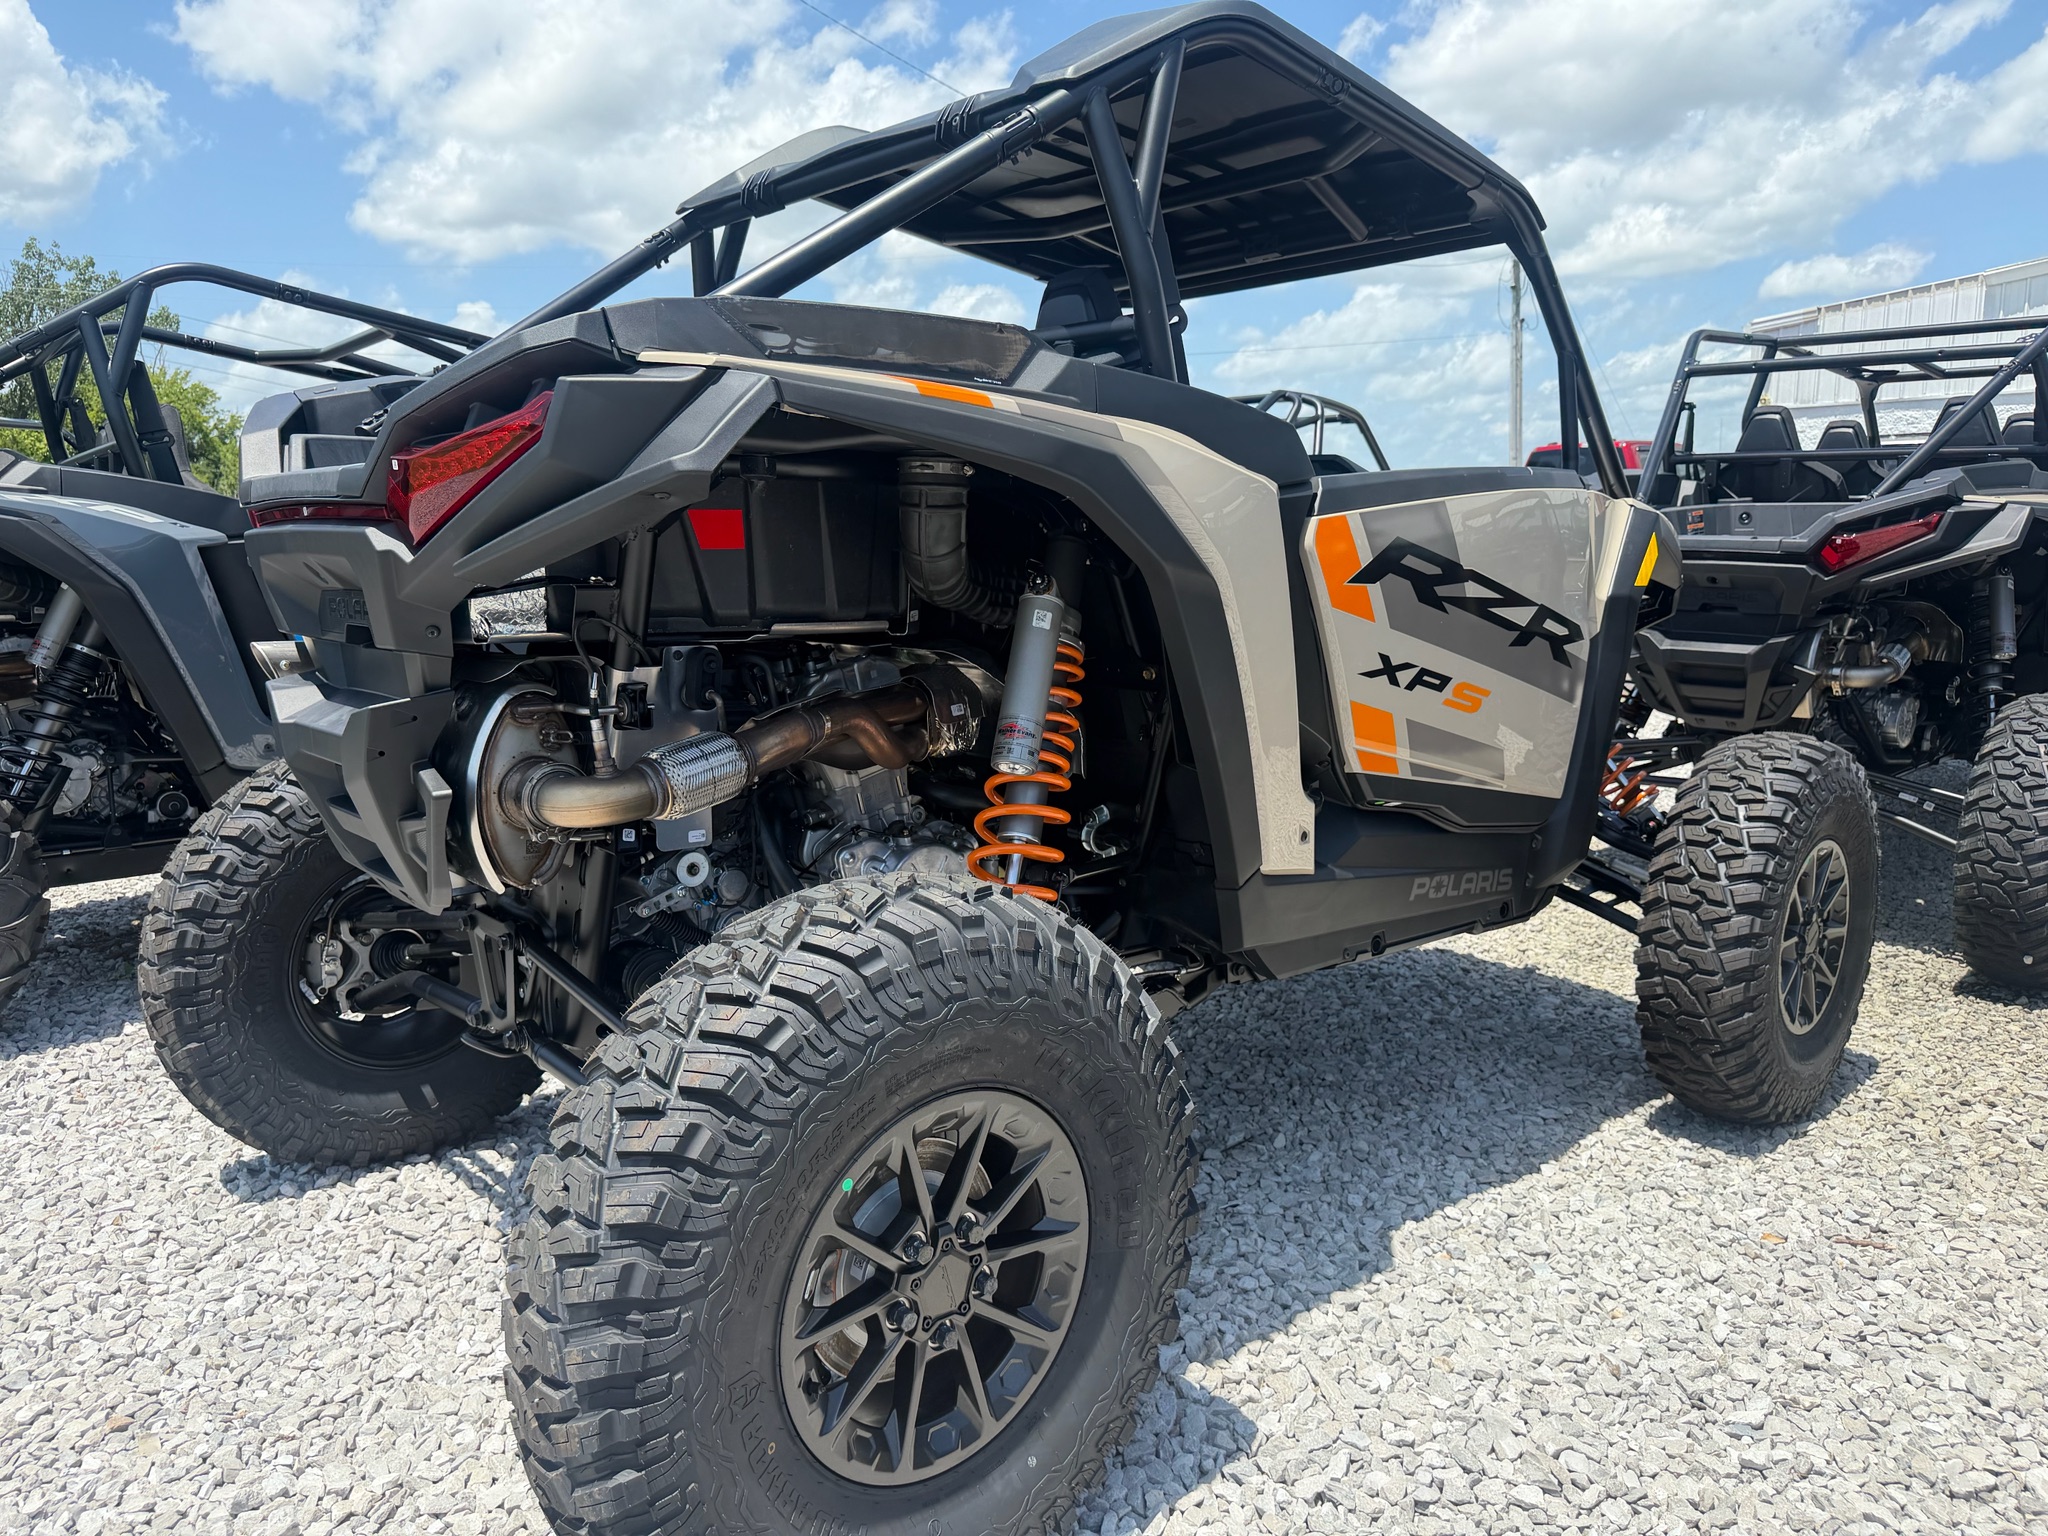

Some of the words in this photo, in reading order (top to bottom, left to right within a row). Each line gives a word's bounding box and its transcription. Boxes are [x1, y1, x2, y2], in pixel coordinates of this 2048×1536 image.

[1345, 536, 1584, 669] RZR
[1357, 651, 1492, 714] XPS
[1409, 867, 1513, 902] POLARIS
